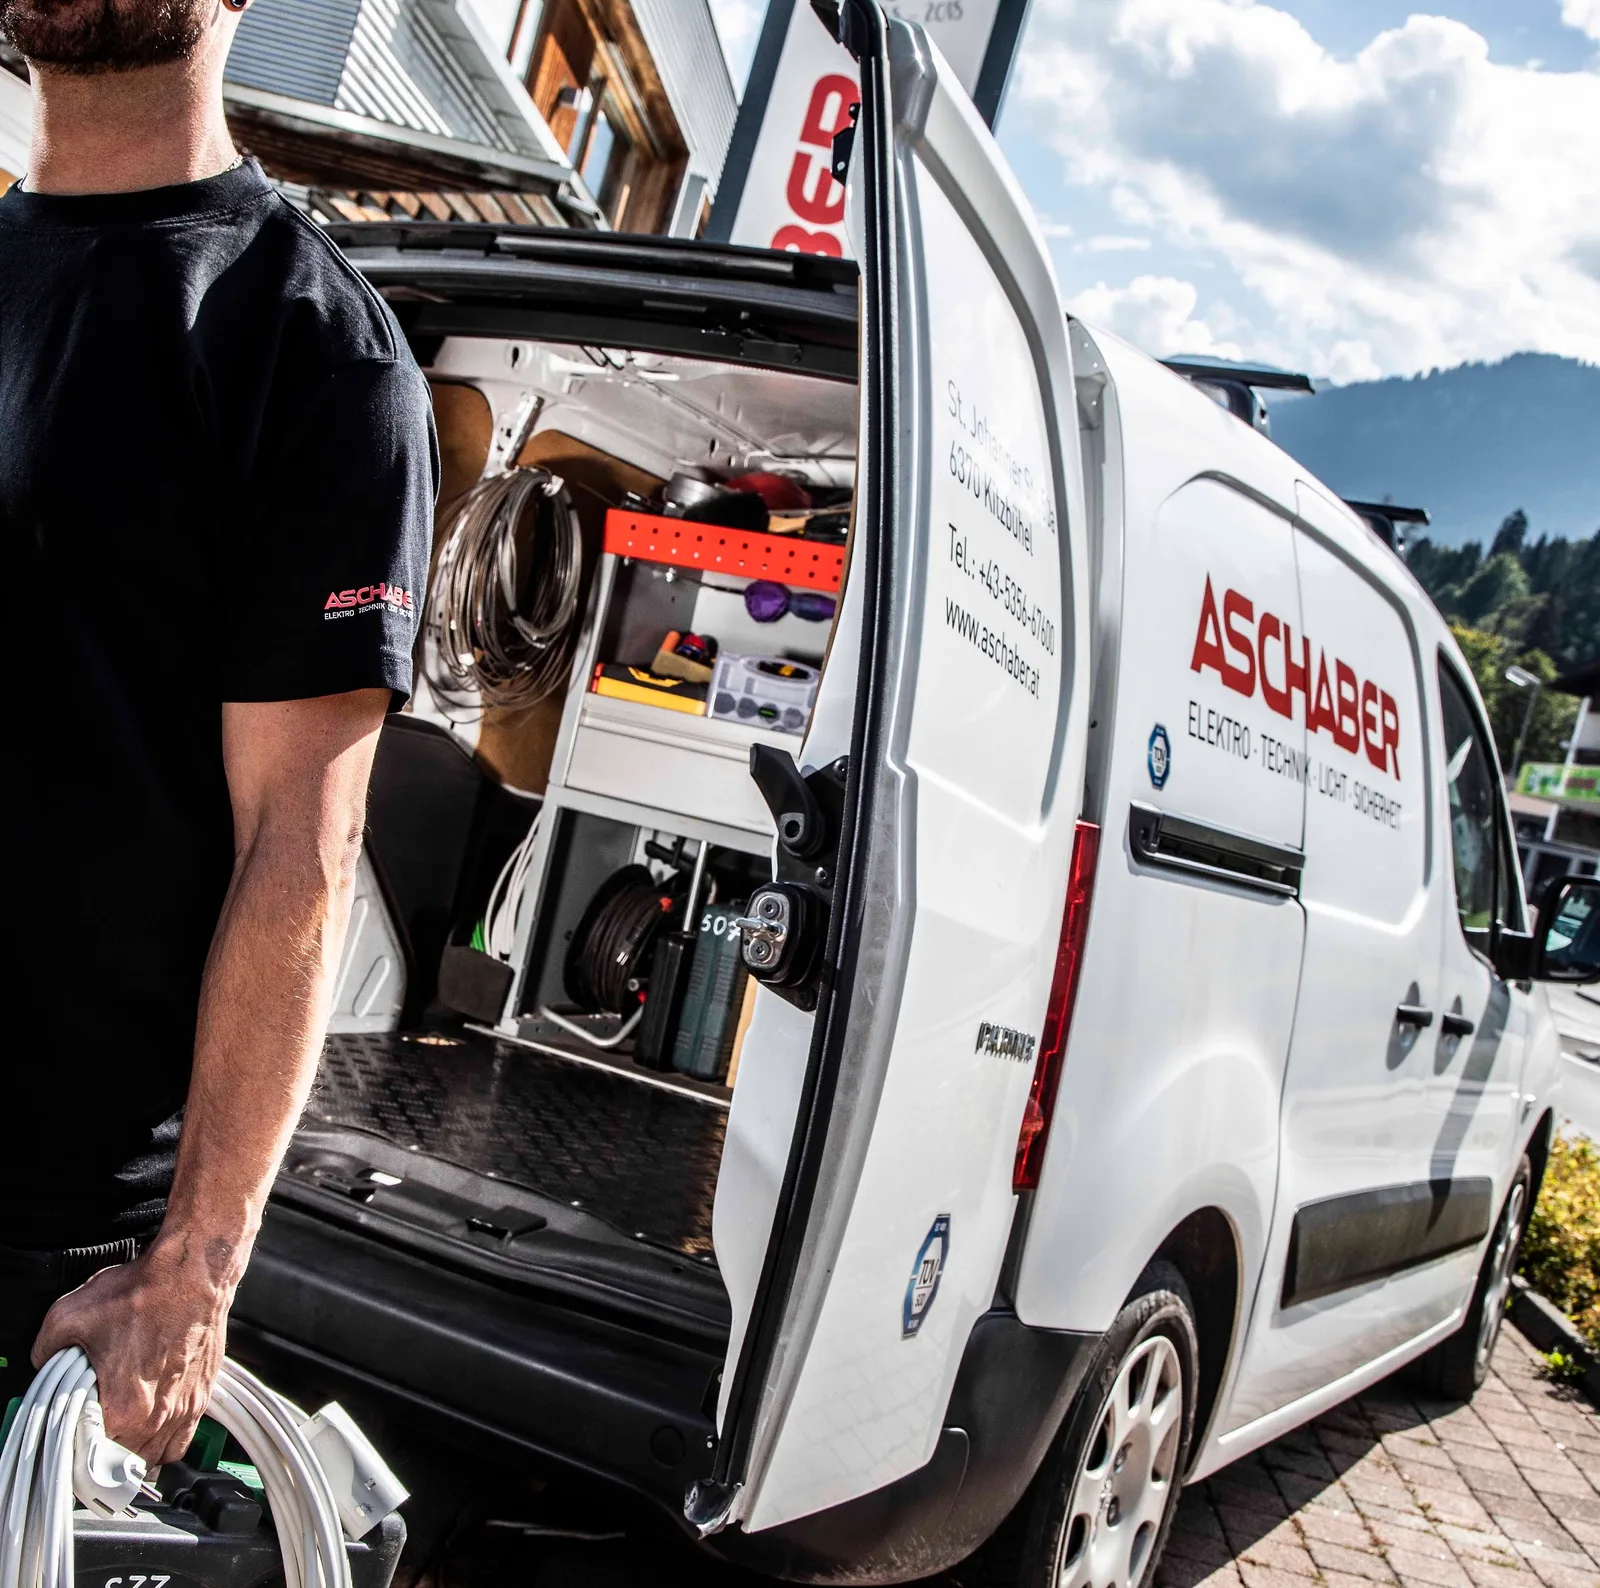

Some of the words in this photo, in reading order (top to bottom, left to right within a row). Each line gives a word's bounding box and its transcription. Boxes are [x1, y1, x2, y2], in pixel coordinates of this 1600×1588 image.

[948, 379, 966, 429] St.
[949, 440, 980, 499] 6370
[984, 471, 1033, 557] Kitzbühel
[324, 582, 415, 611] ASCHABE
[324, 609, 355, 620] ELEKTRO
[358, 602, 386, 614] TECHNIK
[978, 559, 1055, 657] +43-5356-67600
[945, 597, 1040, 701] www.aschaber.at
[1190, 570, 1401, 782] ASCHABER
[1188, 700, 1251, 760] ELEKTRO
[1260, 734, 1313, 788] TECHNIK
[1317, 761, 1348, 803] LICHT
